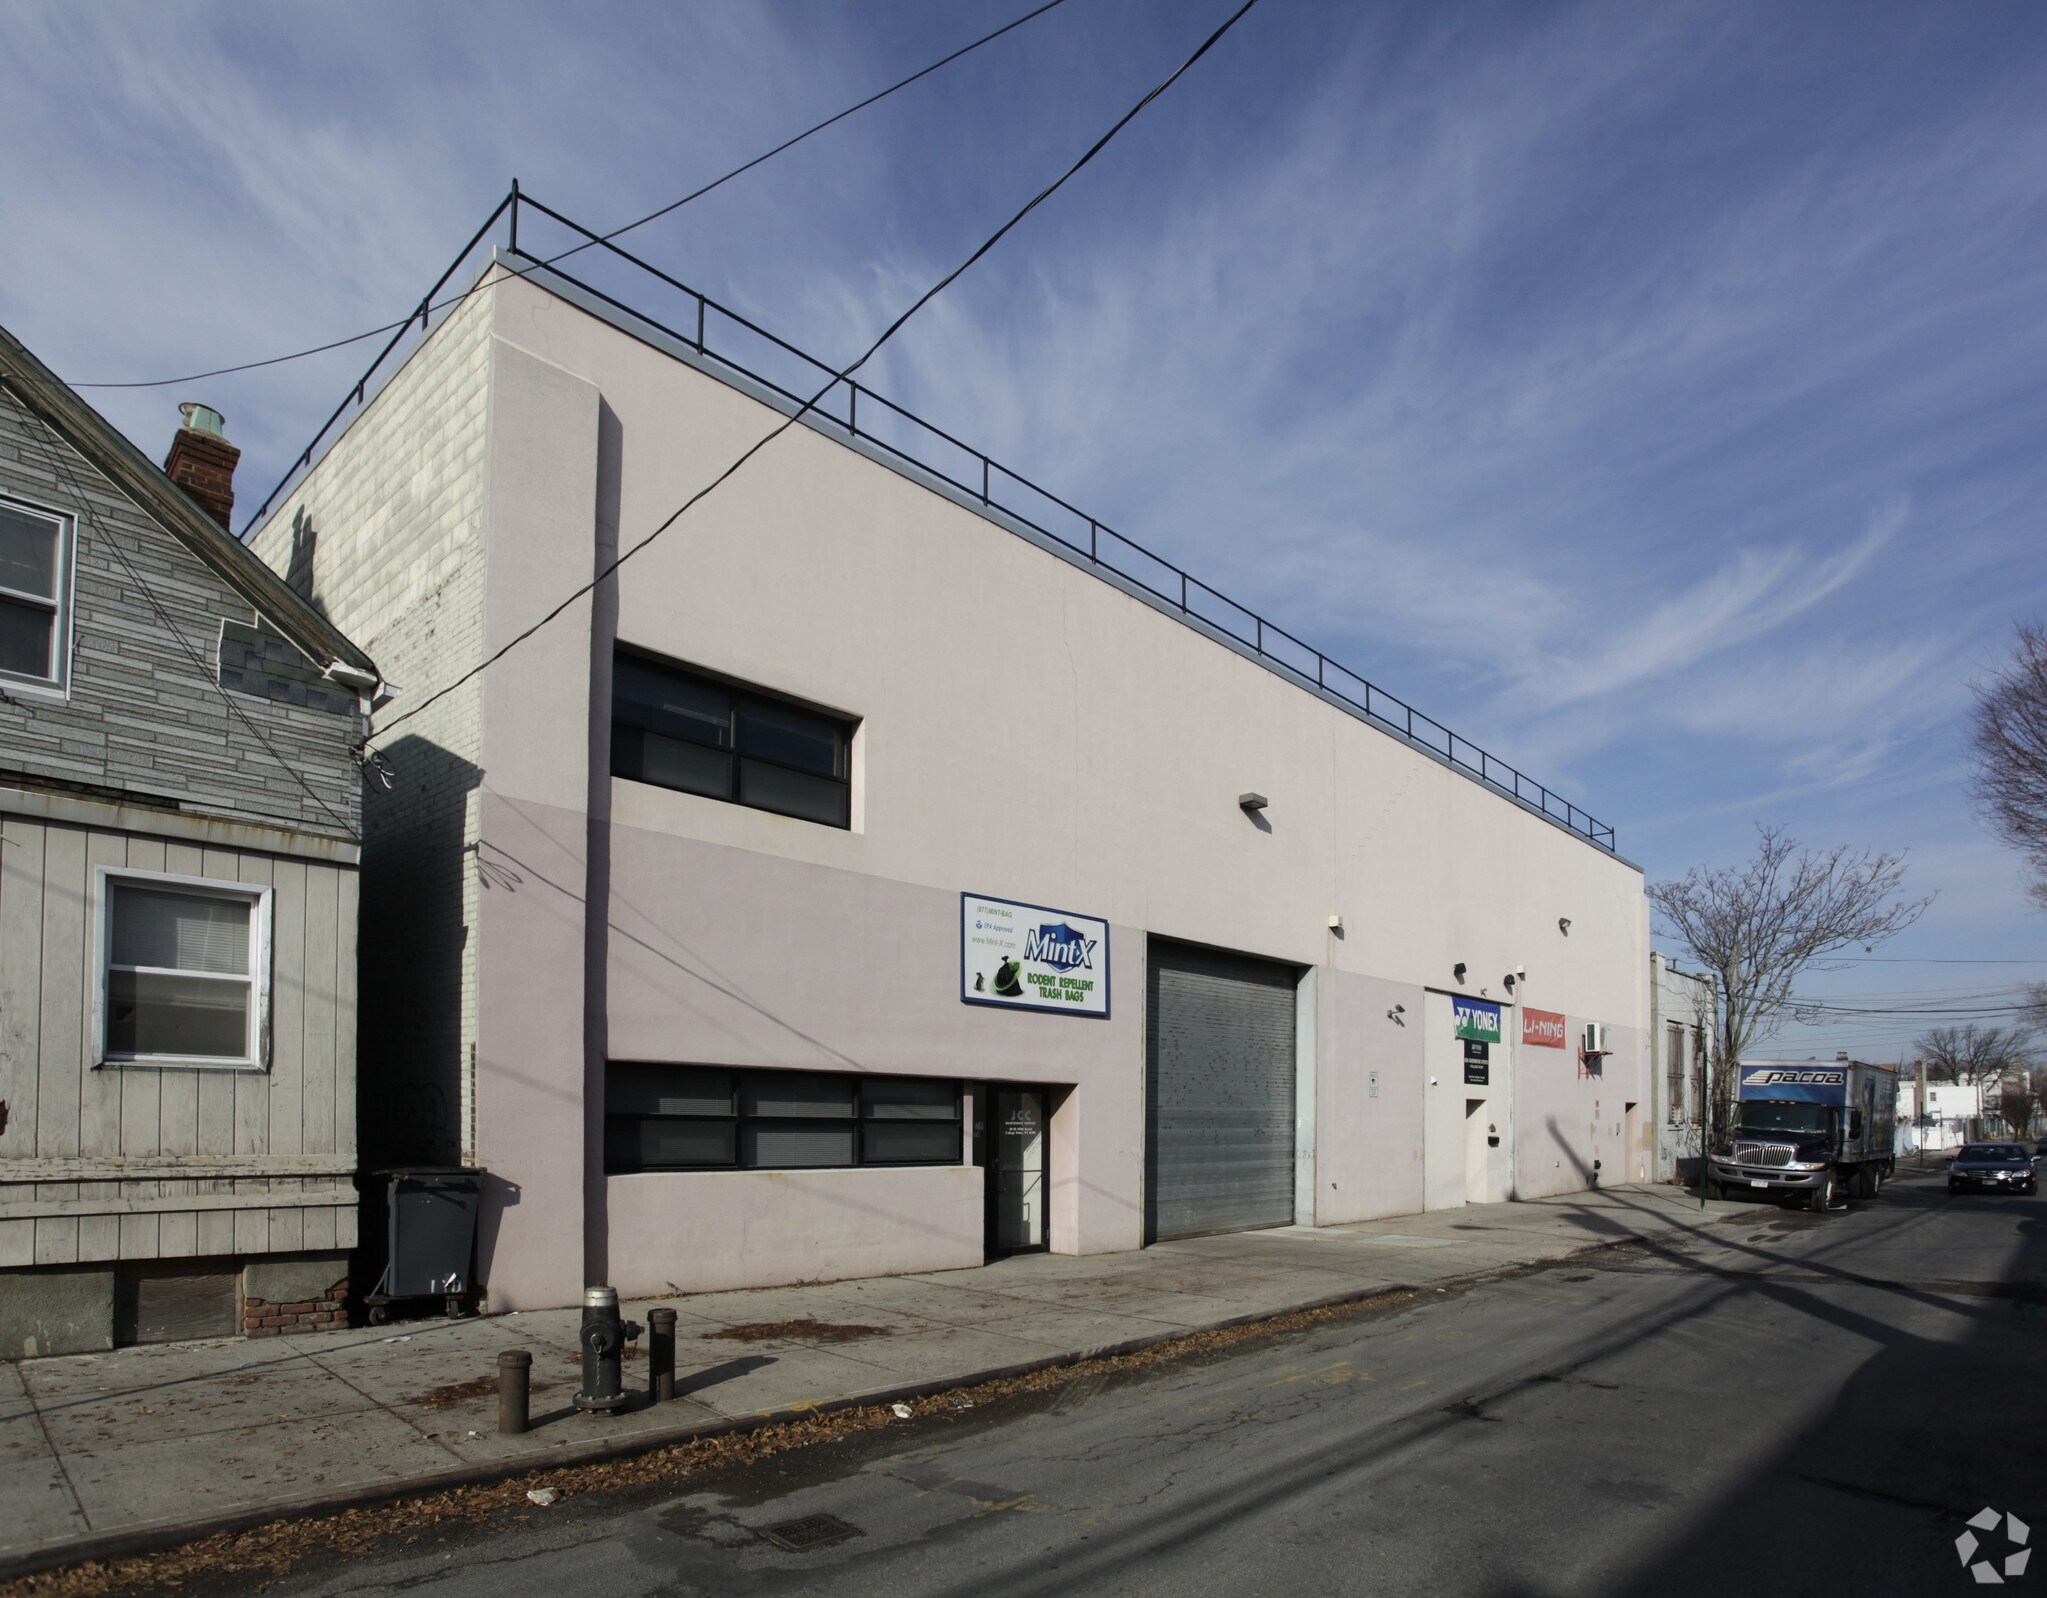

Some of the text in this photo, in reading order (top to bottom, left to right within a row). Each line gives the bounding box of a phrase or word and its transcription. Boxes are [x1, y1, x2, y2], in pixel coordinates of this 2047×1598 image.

[993, 924, 1013, 934] Approved
[1027, 973, 1094, 991] RODENT REPELLENT
[1039, 986, 1084, 1003] TRASH BAGS
[1472, 1010, 1498, 1032] YONEX
[1524, 1019, 1563, 1038] LI-NING
[1011, 1110, 1031, 1120] JCC
